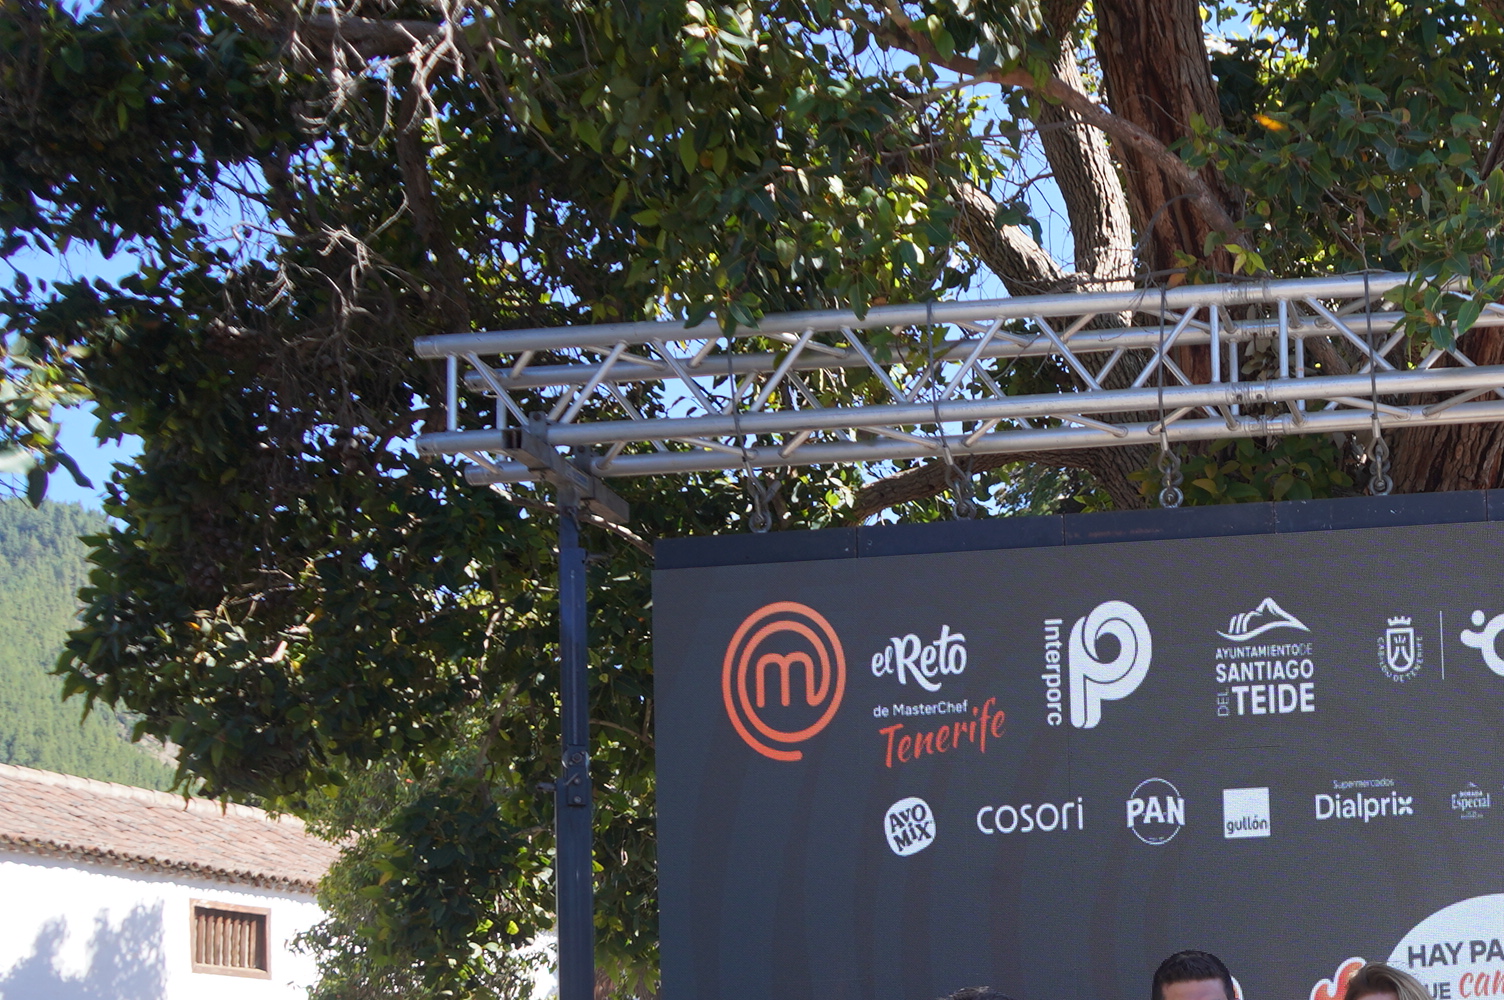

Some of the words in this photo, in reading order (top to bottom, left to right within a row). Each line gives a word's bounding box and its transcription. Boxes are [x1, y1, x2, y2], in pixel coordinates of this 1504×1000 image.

[1041, 618, 1063, 726] Interporc
[1215, 659, 1314, 683] SANTIAGO
[873, 705, 889, 718] de
[893, 699, 968, 717] MasterChef
[1217, 686, 1230, 717] DEL
[1231, 682, 1315, 716] TEIDE
[879, 697, 1006, 768] Tenerife
[1333, 777, 1395, 790] Supermercados
[977, 797, 1083, 834] cosori
[1315, 791, 1413, 823] Dialprix
[1451, 793, 1490, 811] Especial
[1227, 814, 1268, 834] gullón
[1407, 941, 1463, 968] HAY
[1424, 981, 1451, 1000] UE
